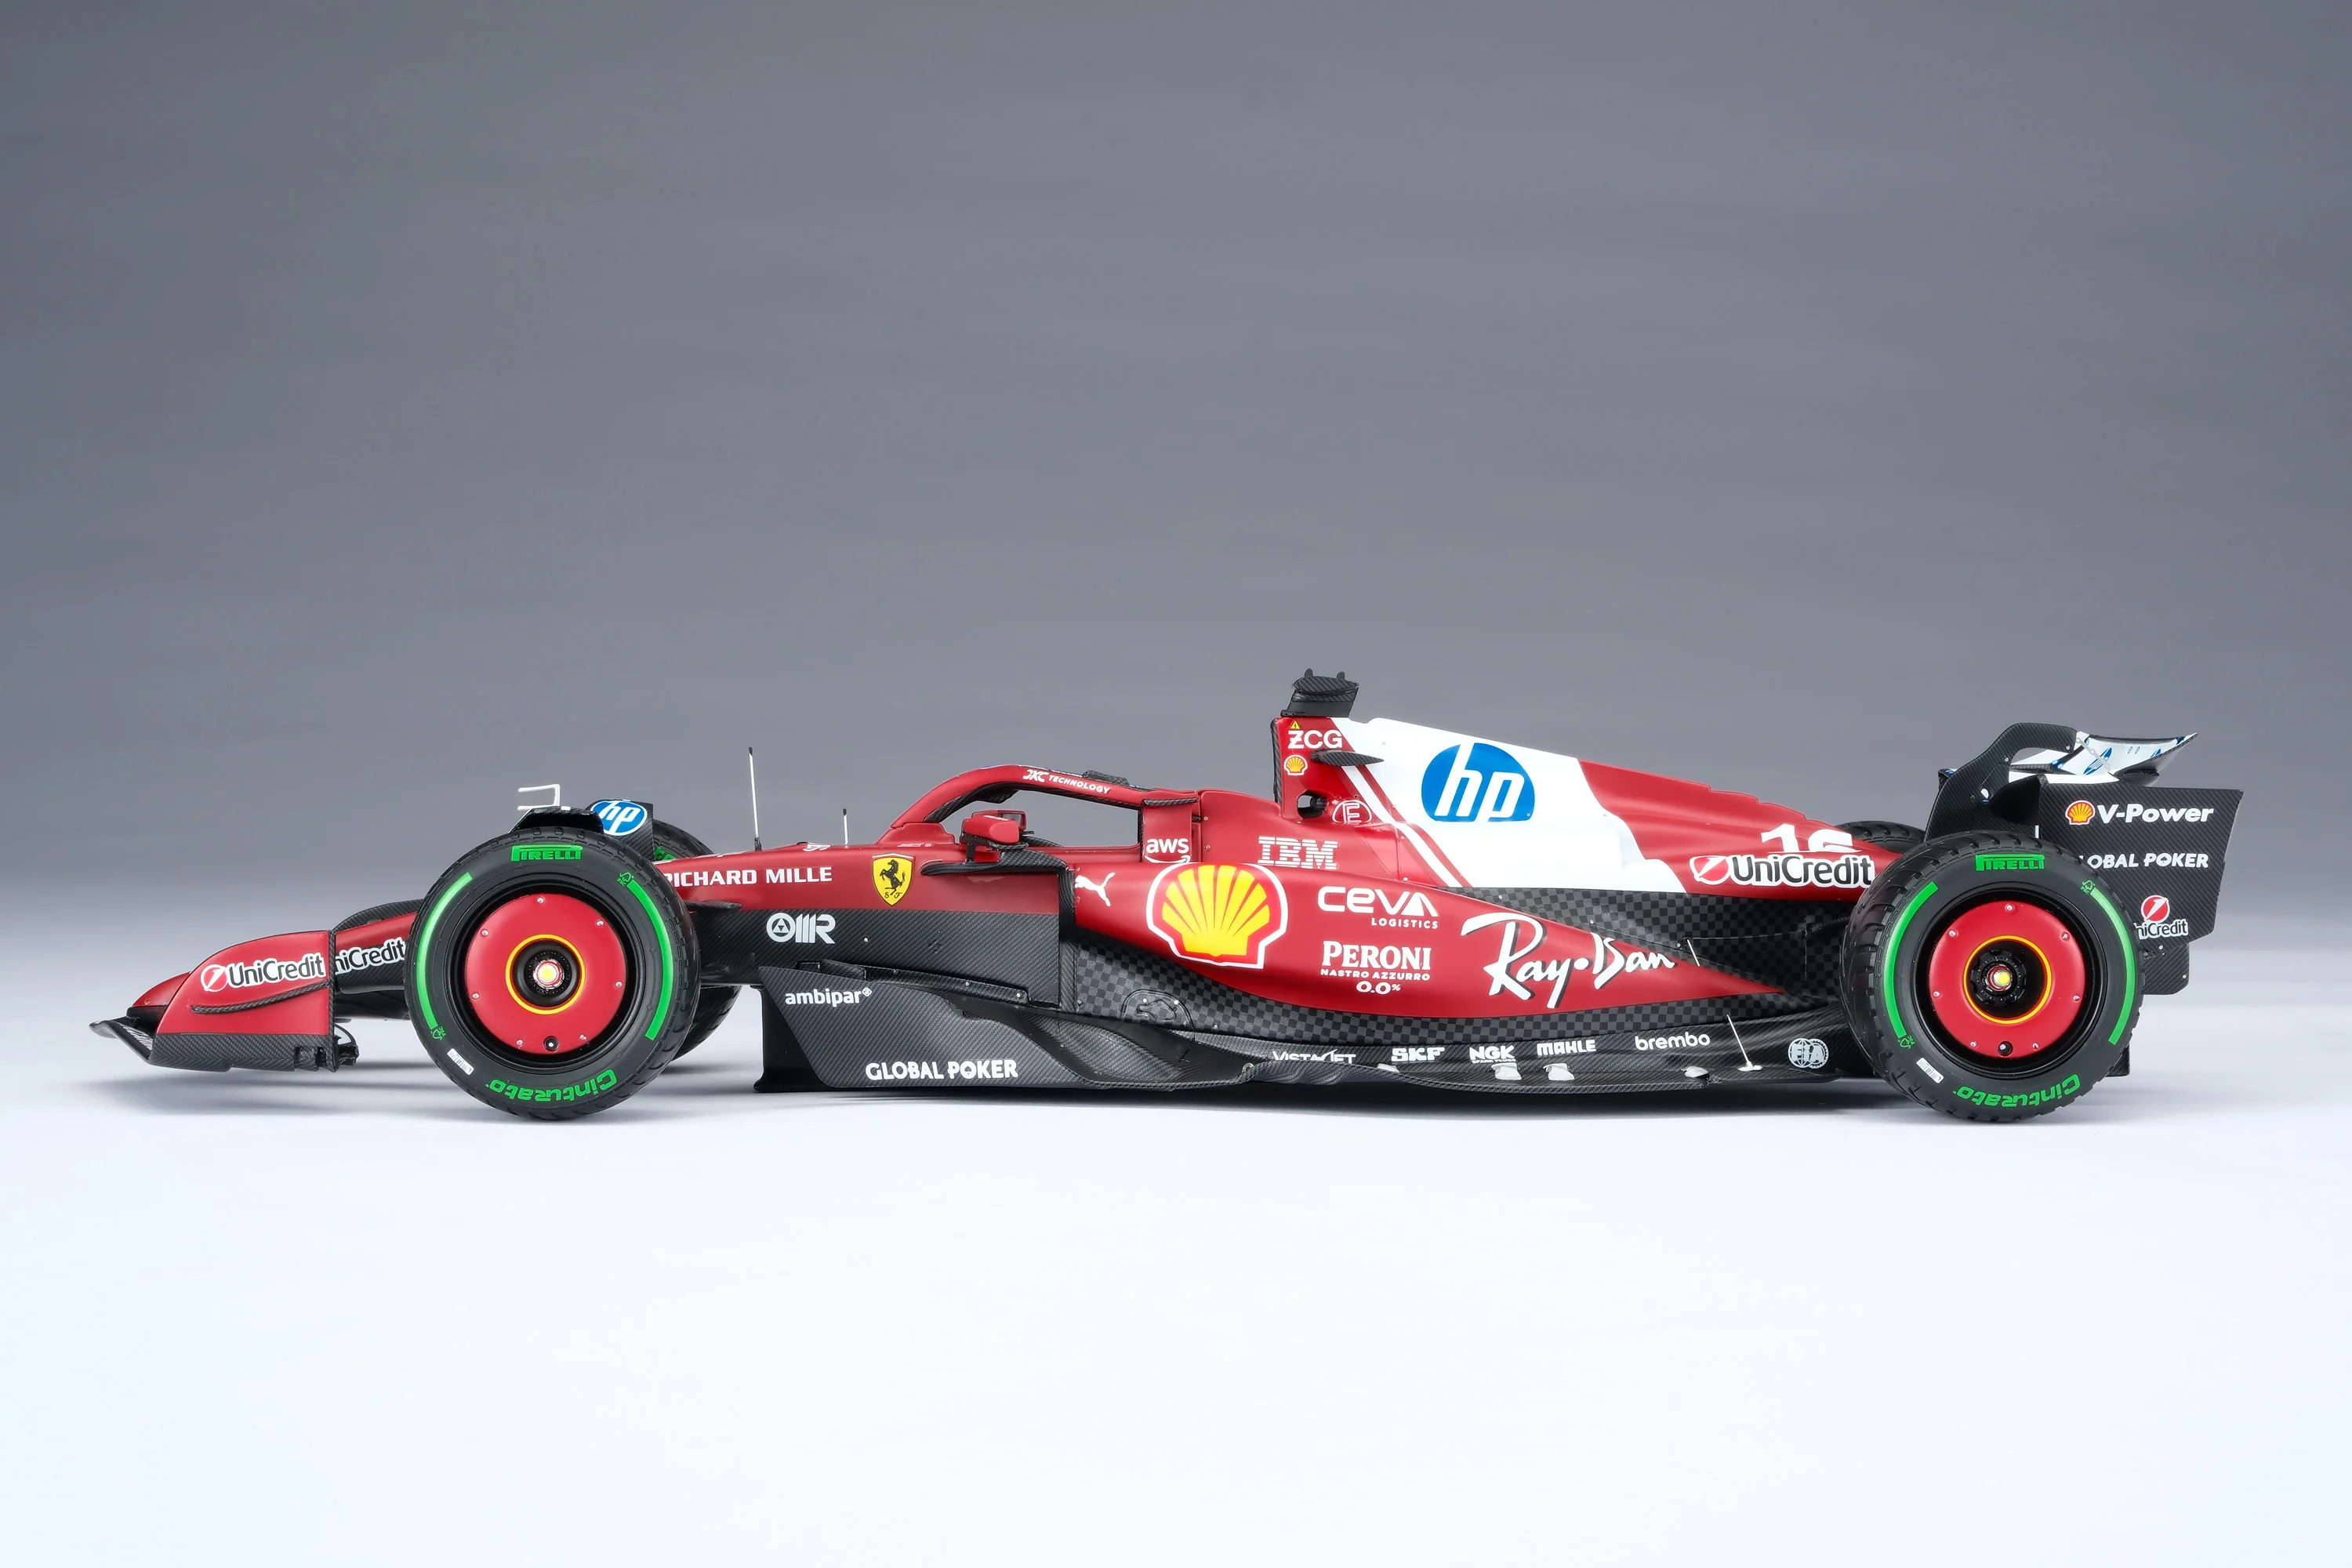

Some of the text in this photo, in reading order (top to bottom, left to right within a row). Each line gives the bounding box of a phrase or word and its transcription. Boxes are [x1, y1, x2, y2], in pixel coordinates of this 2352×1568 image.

[1048, 775, 1112, 793] TECHNOLOGY
[1434, 742, 1525, 822] hp
[597, 800, 641, 835] hp
[2096, 804, 2215, 823] V-Power
[511, 844, 583, 862] PIRELLI
[1145, 838, 1190, 854] aws
[1258, 836, 1338, 870] IBM
[1976, 854, 2045, 871] PIRELLI
[2078, 852, 2209, 869] OBAL POKER
[765, 866, 833, 884] MILLE
[1731, 855, 1872, 885] UniCredit
[1370, 917, 1439, 930] LOGISTICS
[2136, 920, 2187, 938] niCredit
[335, 939, 405, 973] niCredit
[1321, 940, 1432, 971] PERONI
[227, 953, 326, 987] UniCredit
[1320, 968, 1431, 982] NASTRO AZZURRO
[1356, 980, 1401, 995] 0.0%
[785, 988, 862, 1007] ambipar
[1537, 1039, 1597, 1056] MAHLE
[1635, 1032, 1711, 1051] brembo
[1391, 1047, 1446, 1062] SKF
[1469, 1044, 1515, 1061] NGK
[865, 1059, 1019, 1080] GLOBAL POKER
